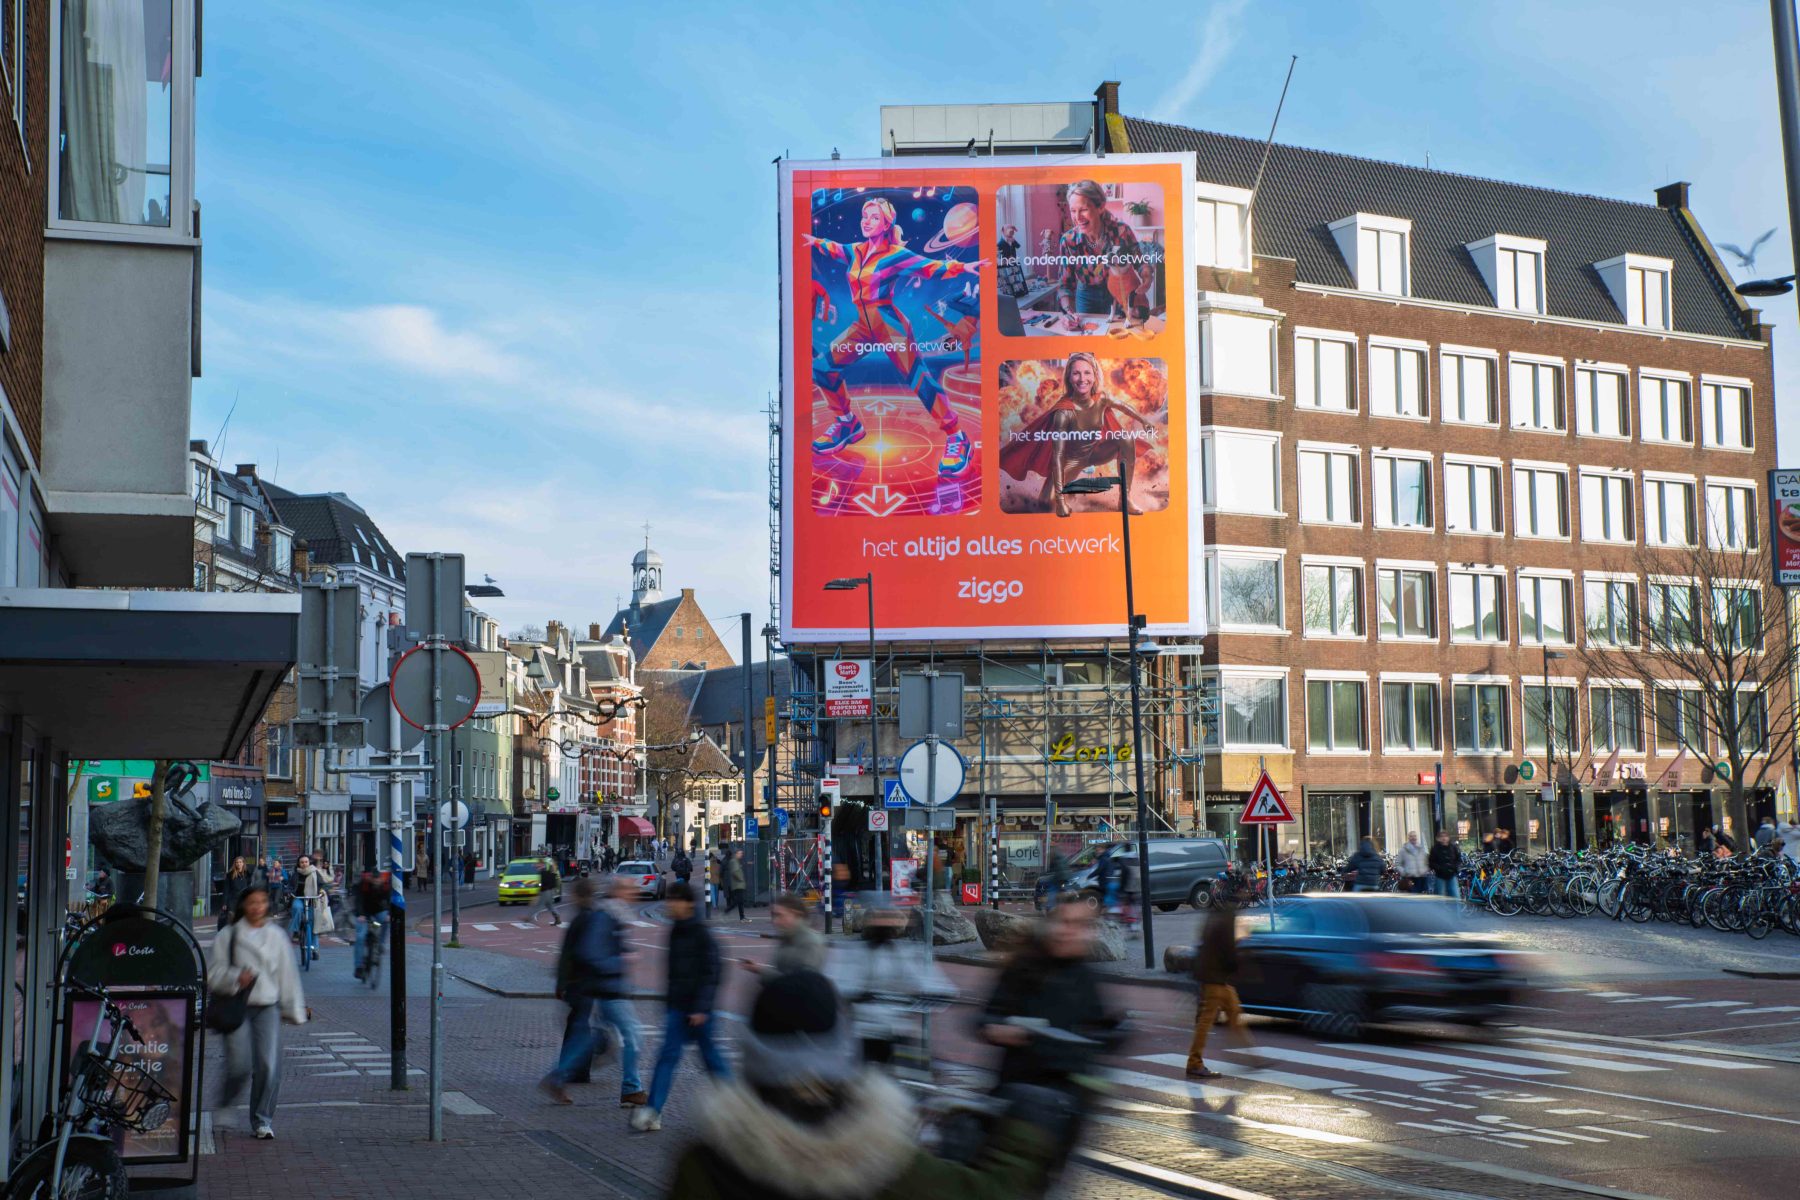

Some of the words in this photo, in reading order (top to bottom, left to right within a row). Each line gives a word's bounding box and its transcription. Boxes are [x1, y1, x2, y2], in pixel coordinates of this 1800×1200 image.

[1000, 254, 1021, 266] het
[1023, 253, 1109, 266] ondernemers
[1111, 251, 1164, 265] netwerk
[830, 341, 852, 353] het
[854, 341, 907, 355] gamers
[909, 339, 963, 352] netwerk
[1009, 429, 1031, 442] het
[1033, 429, 1103, 442] streamers
[1105, 428, 1159, 441] netwerk
[863, 537, 898, 557] het
[903, 535, 961, 561] altijd
[965, 535, 1023, 555] alles
[1029, 532, 1121, 555] netwerk
[957, 576, 1024, 604] ziggo
[1007, 845, 1040, 860] Lorjé
[115, 945, 127, 957] La
[128, 945, 155, 956] Costa
